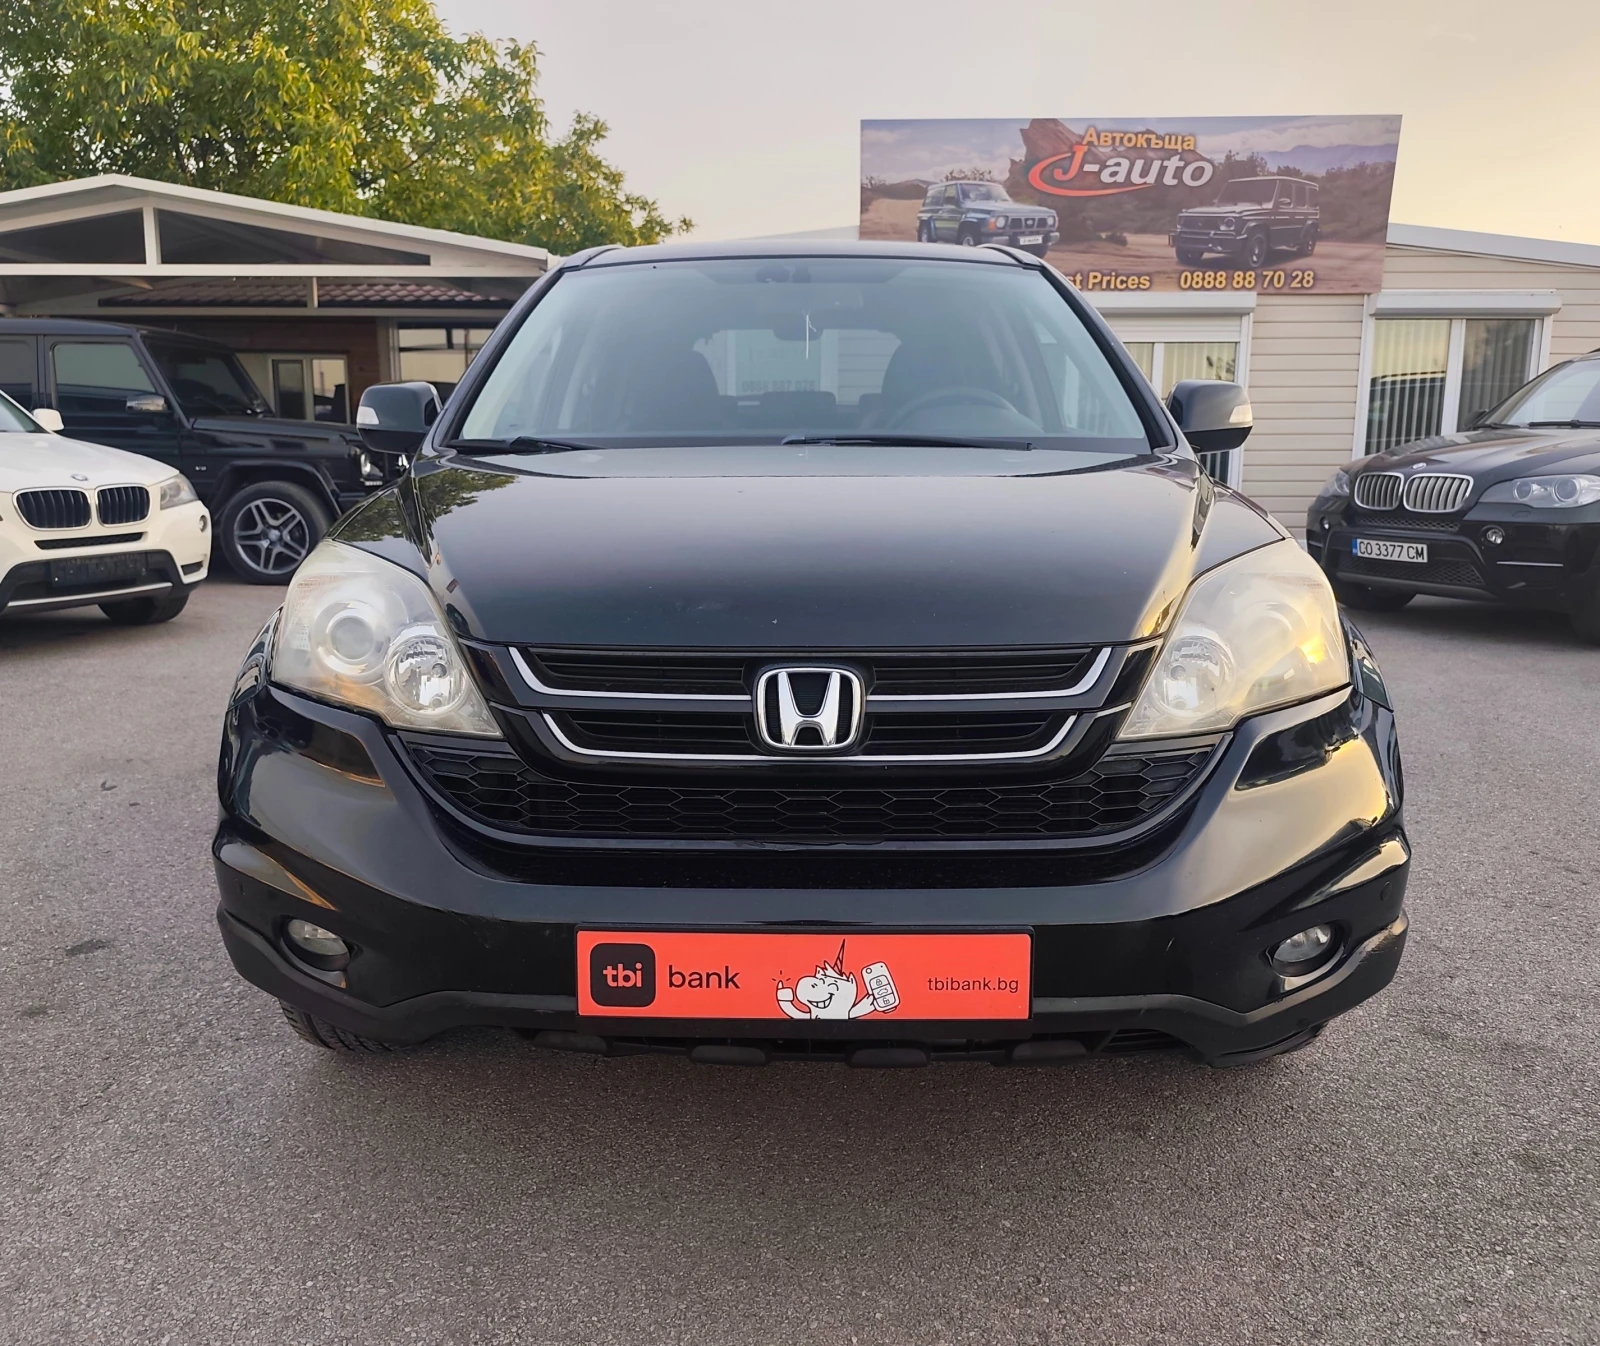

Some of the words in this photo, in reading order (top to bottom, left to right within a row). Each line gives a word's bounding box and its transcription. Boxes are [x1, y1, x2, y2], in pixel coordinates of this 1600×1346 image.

[1082, 127, 1195, 152] Автокъща
[1053, 145, 1213, 187] J-auto
[1087, 271, 1151, 290] Prices
[1180, 271, 1227, 289] 0888
[1232, 270, 1256, 289] 88
[1262, 270, 1285, 289] 70
[1290, 270, 1315, 288] 28
[1358, 541, 1373, 556] CO
[1375, 543, 1404, 559] 3377
[1406, 546, 1425, 561] CM
[602, 962, 643, 988] tbi
[667, 964, 741, 990] bank
[927, 976, 1019, 994] tbibank.bg
